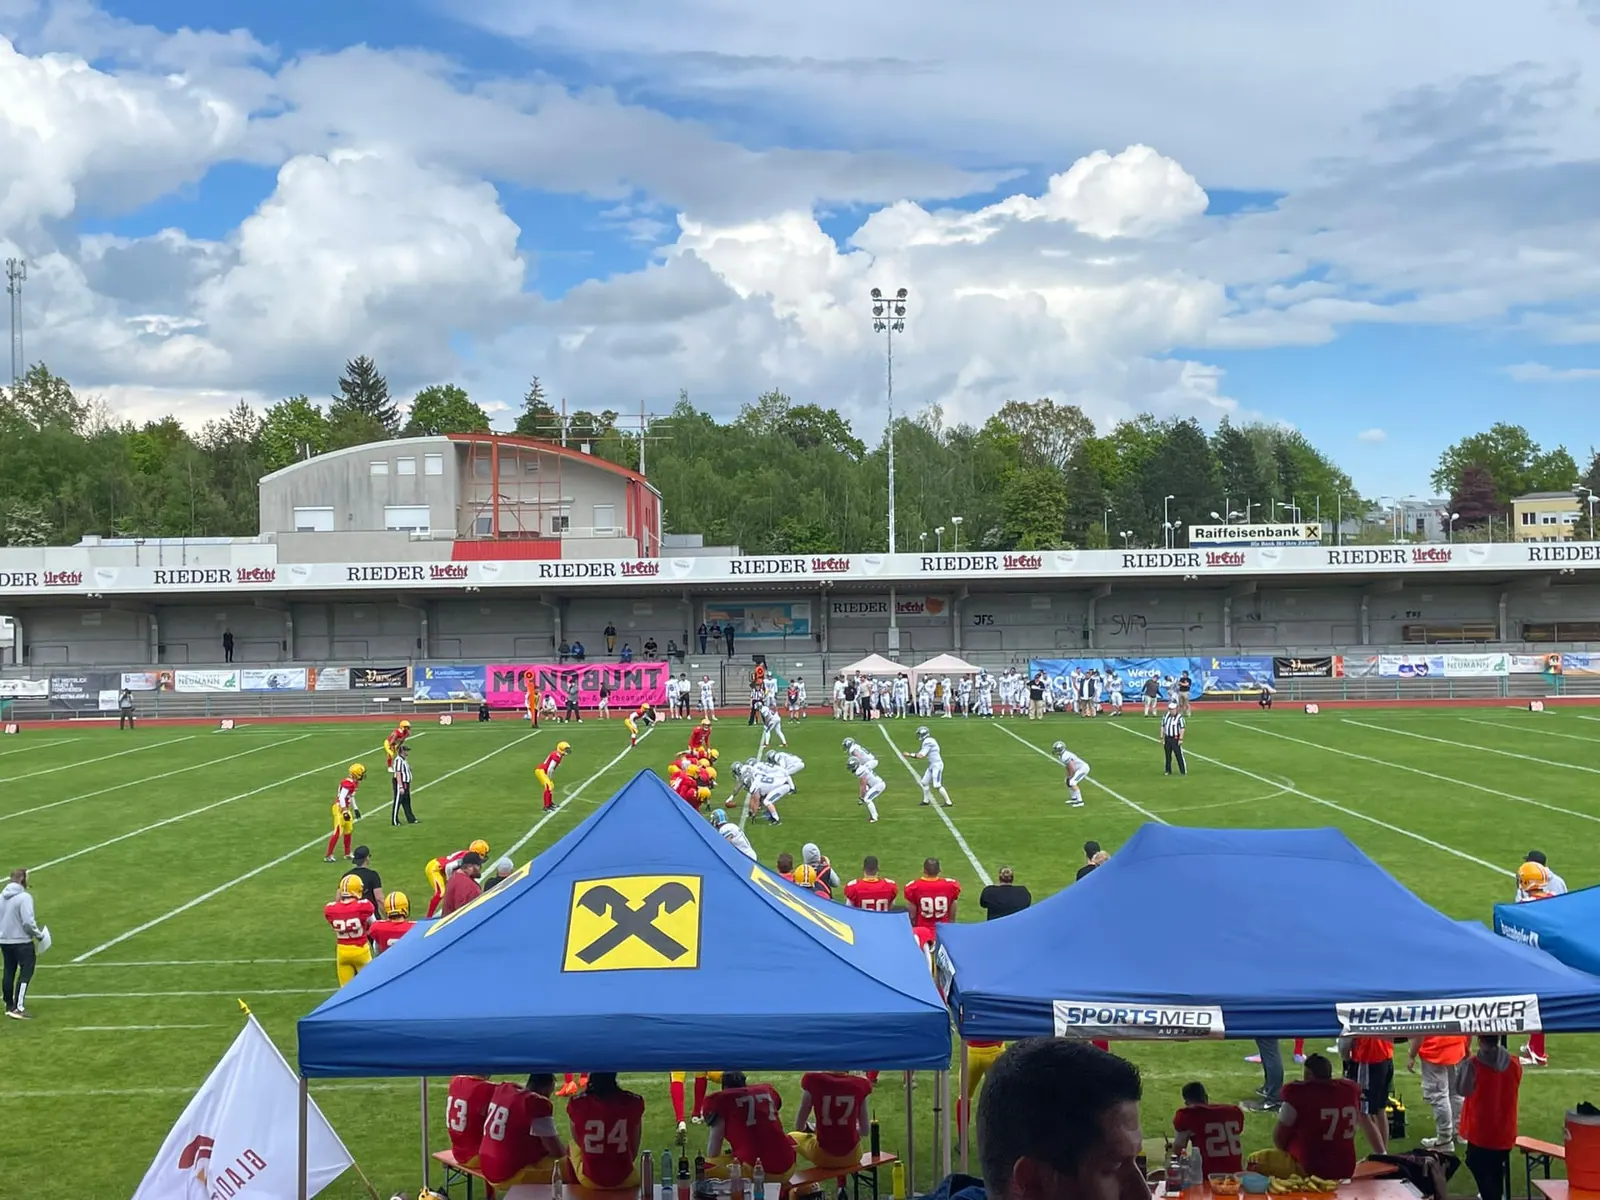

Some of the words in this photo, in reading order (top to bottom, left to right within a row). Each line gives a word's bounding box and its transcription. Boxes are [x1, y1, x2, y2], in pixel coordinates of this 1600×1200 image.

[1195, 526, 1300, 539] Raiffeisenbank
[920, 556, 999, 572] RIEDER
[1122, 553, 1201, 568] RIEDER
[1327, 549, 1408, 565] RIEDER
[347, 566, 425, 582] RIEDER
[539, 563, 617, 579] RIEDER
[730, 559, 807, 575] RIEDER
[0, 572, 39, 587] DER
[153, 569, 232, 585] RIEDER
[832, 602, 888, 613] RIEDER
[1447, 661, 1489, 669] NEUMANN
[920, 896, 948, 918] 99
[332, 917, 364, 939] 23
[1067, 1007, 1213, 1026] SPORTSMED
[1349, 1000, 1527, 1024] HEALTHPOWER
[1461, 1019, 1518, 1032] RACING
[735, 1093, 777, 1127] 77
[821, 1095, 855, 1126] 17
[1320, 1106, 1358, 1141] 73
[584, 1118, 629, 1154] 24
